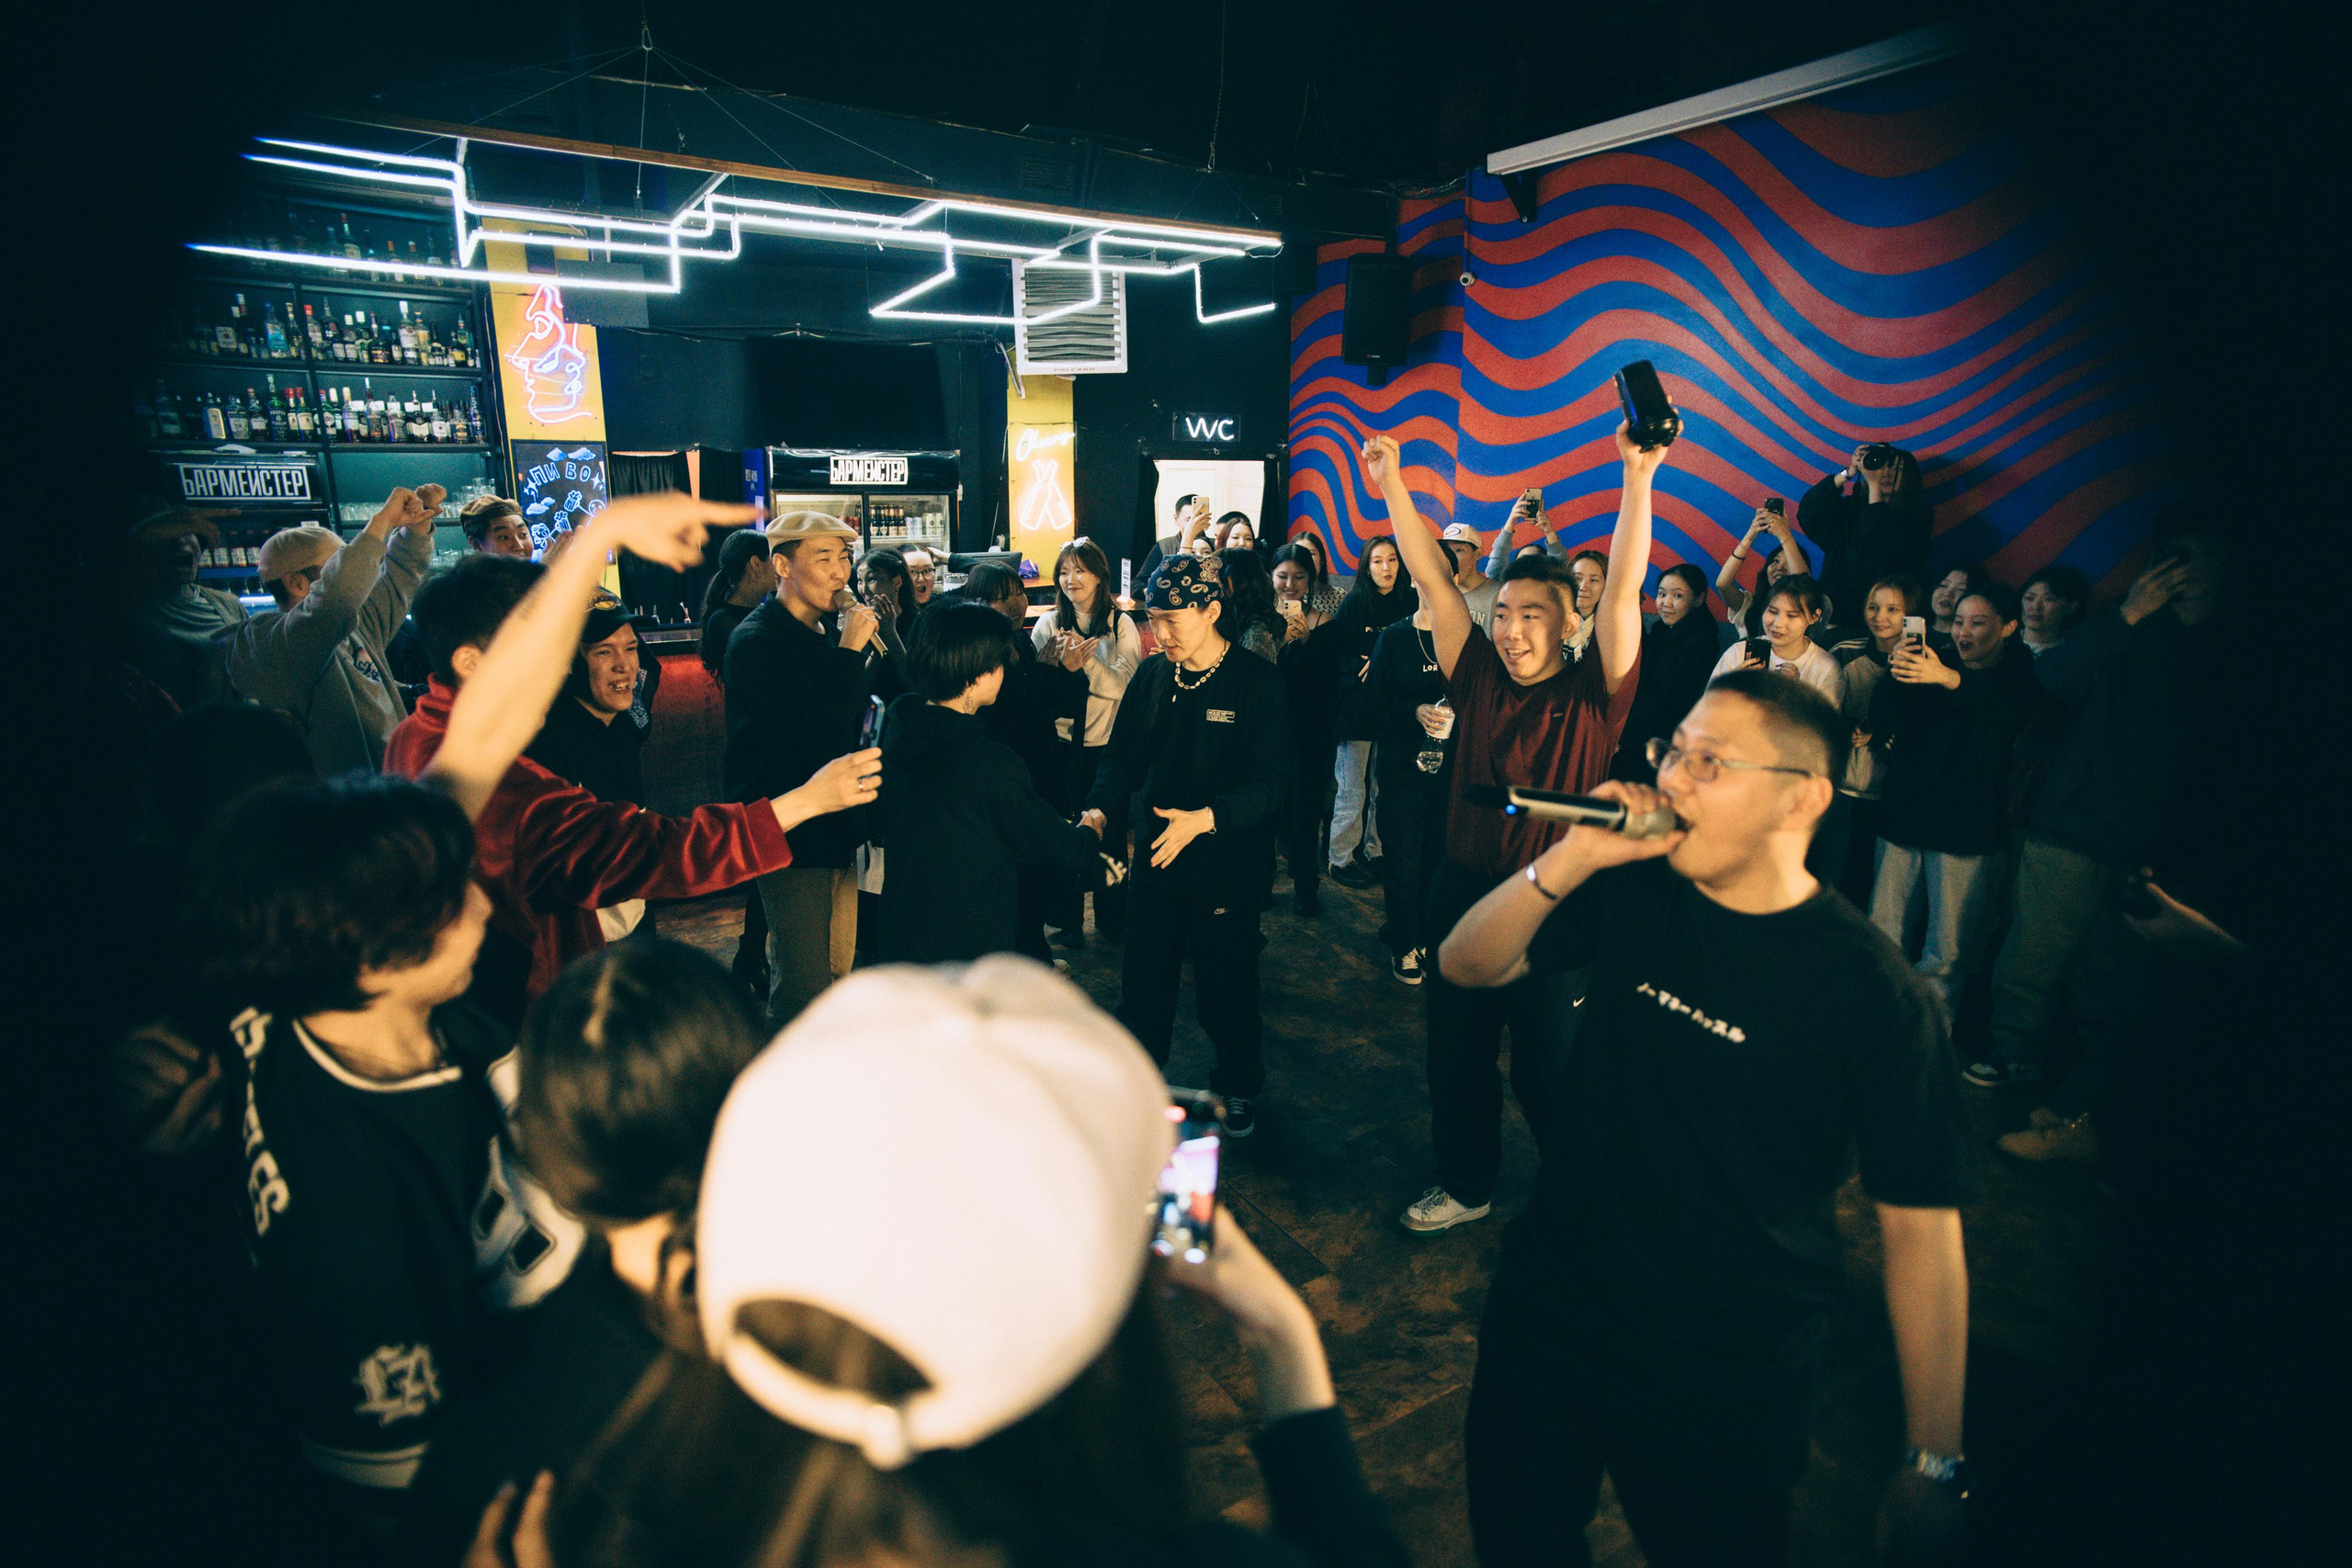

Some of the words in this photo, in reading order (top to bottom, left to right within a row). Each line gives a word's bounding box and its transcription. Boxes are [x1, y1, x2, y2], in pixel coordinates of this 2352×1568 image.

[1185, 417, 1235, 441] WC
[182, 467, 306, 497] БАРМЕЙСТЕР
[831, 457, 906, 483] БАРМЕЙСТЕР
